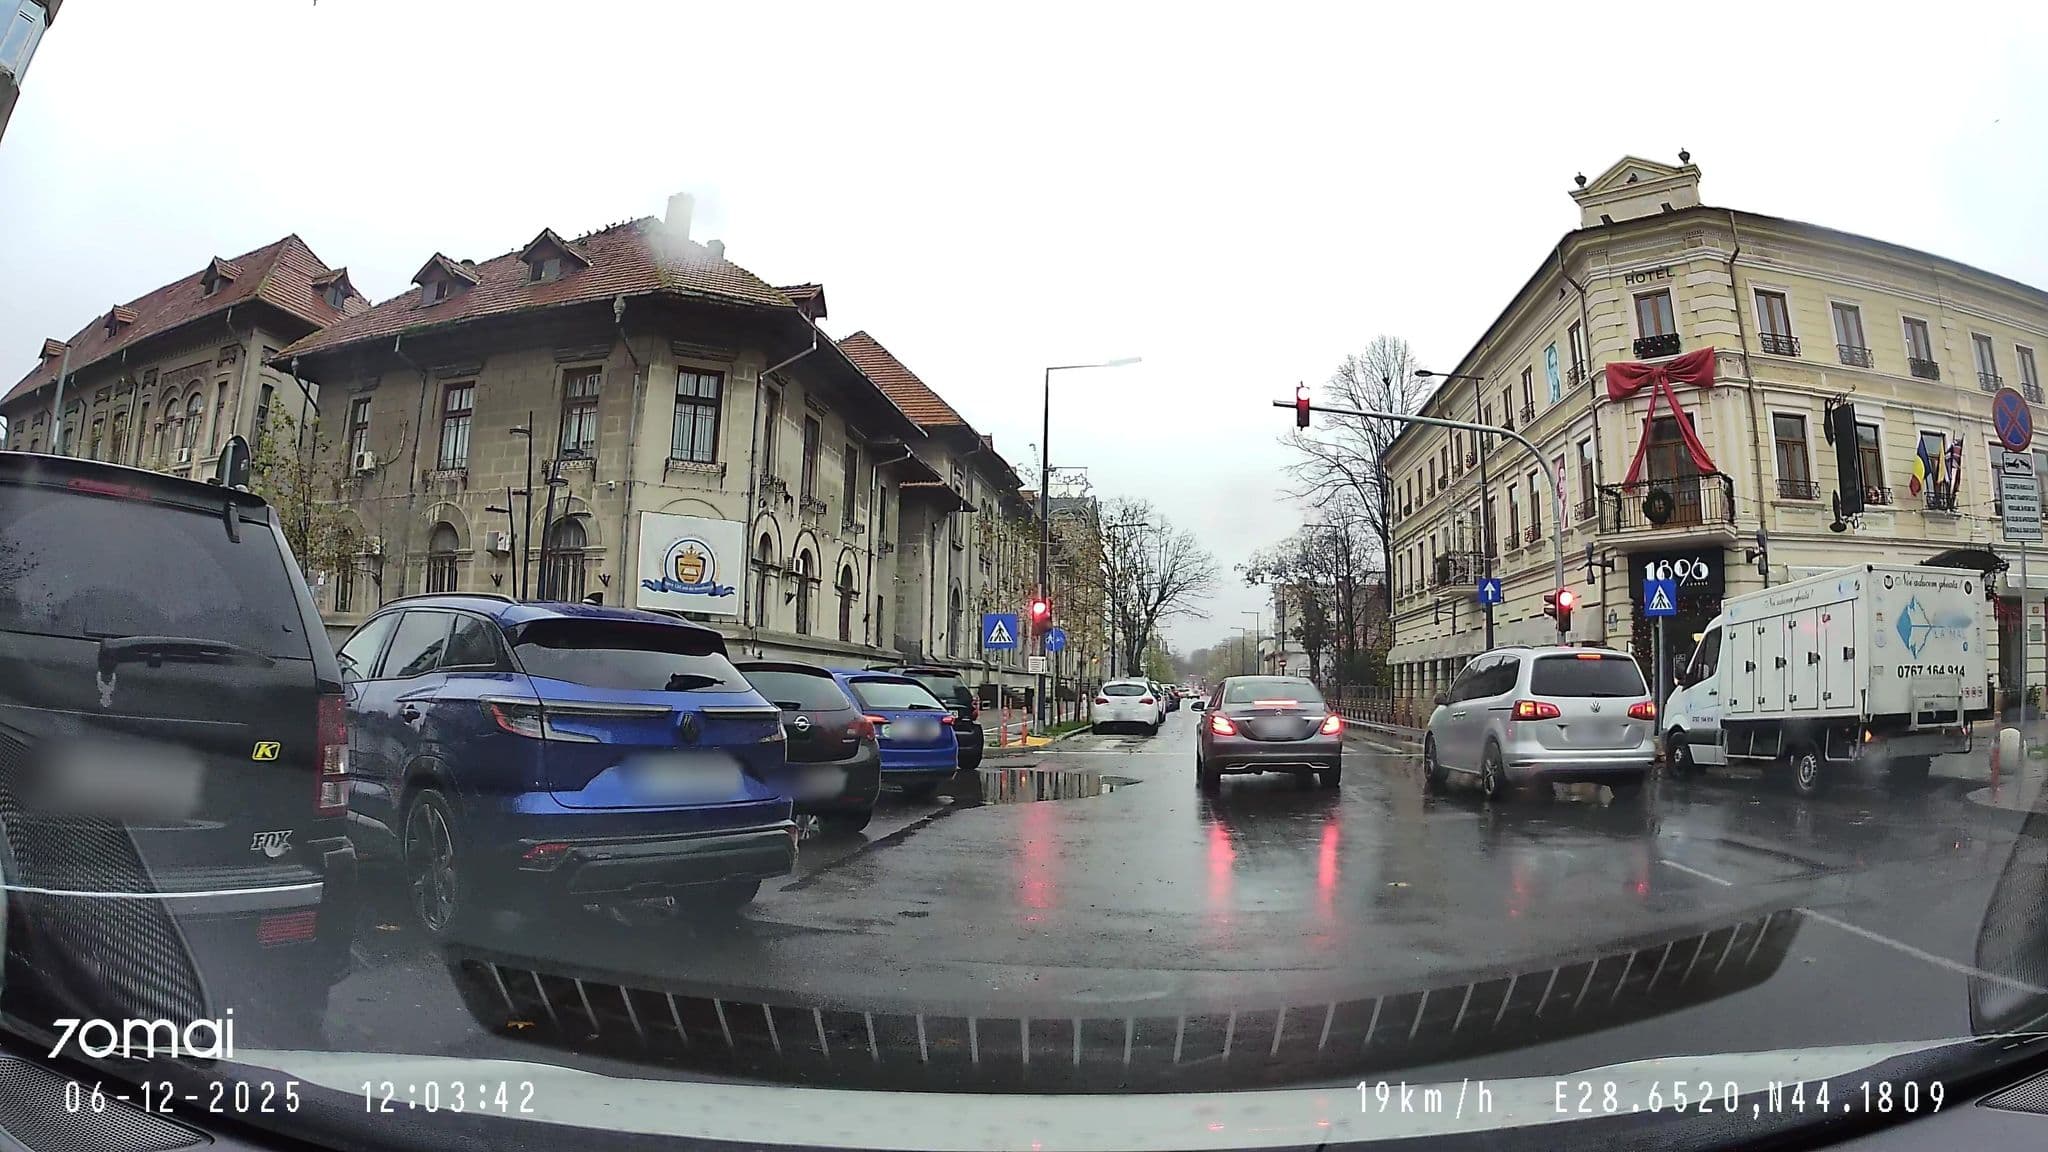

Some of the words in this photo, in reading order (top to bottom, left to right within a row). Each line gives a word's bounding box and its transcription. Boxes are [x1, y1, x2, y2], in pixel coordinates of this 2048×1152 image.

[1625, 268, 1676, 285] HOTEL
[1644, 557, 1709, 587] 1896
[1897, 665, 1923, 678] 0767
[1926, 665, 1945, 676] 164
[1947, 665, 1965, 677] 914
[255, 744, 278, 758] K
[250, 830, 293, 853] FOX
